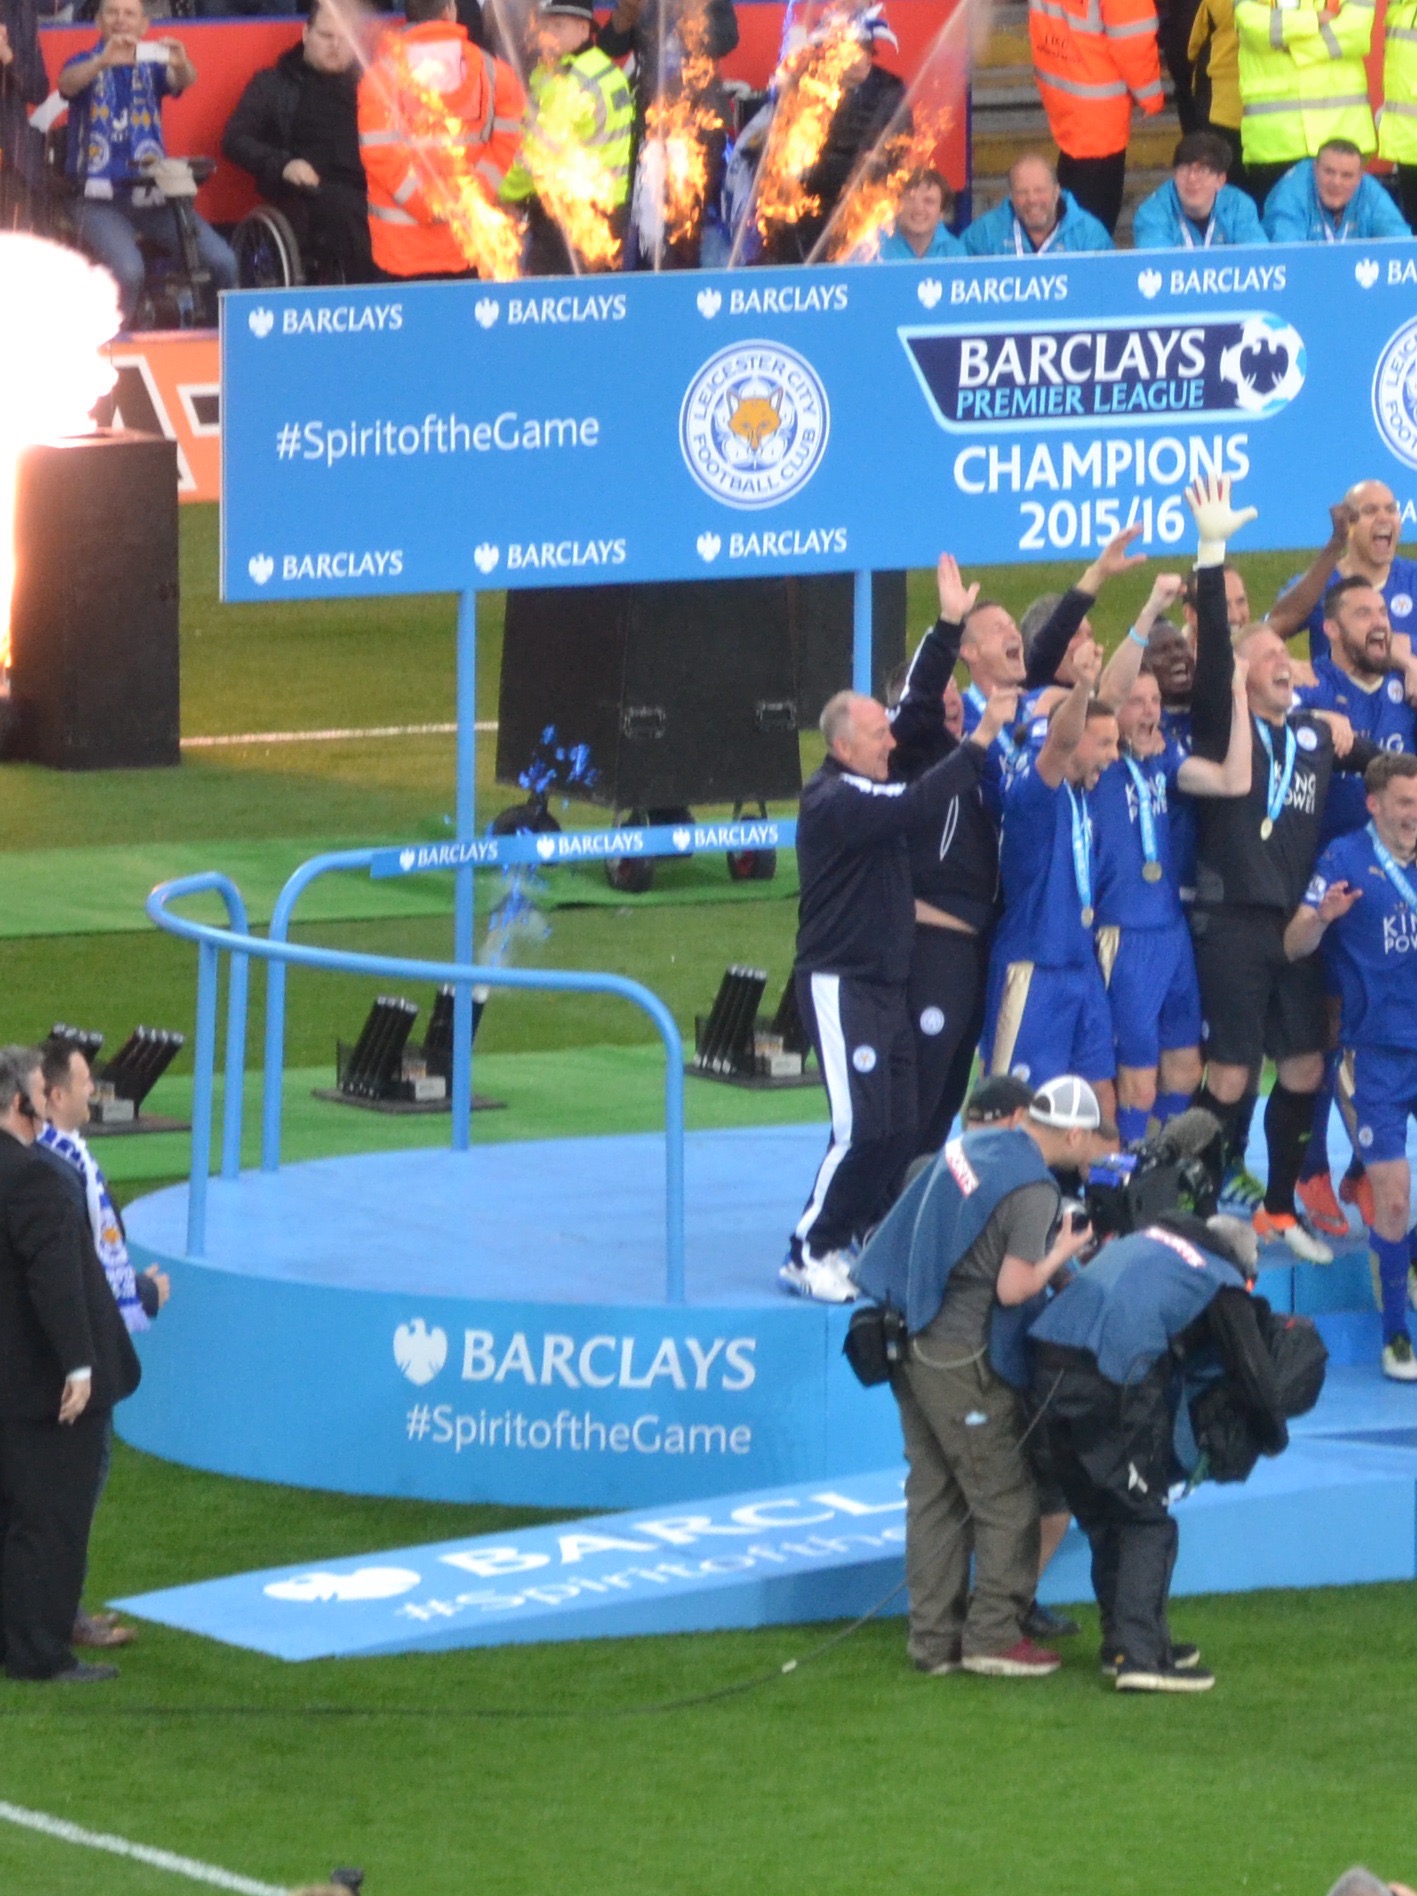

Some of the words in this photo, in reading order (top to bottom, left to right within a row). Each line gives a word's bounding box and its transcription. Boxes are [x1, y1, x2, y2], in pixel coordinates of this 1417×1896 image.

[950, 274, 1068, 304] BARCLAYS
[1170, 265, 1287, 295] BARCLAYS
[507, 294, 627, 325] BARCLAYS
[729, 284, 848, 315] BARCLAYS
[282, 303, 403, 334] BARCLAYS
[957, 328, 1206, 389] BARCLAYS
[694, 355, 786, 421] LEICESTER
[787, 371, 817, 416] CITY
[955, 385, 1083, 420] PREMIER
[1094, 379, 1206, 414] LEAGUE
[276, 411, 600, 468] #SpiritoftheGame
[693, 434, 778, 493] FOOTBALL
[780, 427, 817, 480] CLUB
[953, 433, 1250, 494] CHAMPIONS
[1018, 495, 1186, 550] 2015/16
[507, 538, 627, 570] BARCLAYS
[729, 527, 848, 559] BARCLAYS
[282, 550, 404, 581] BARCLAYS
[1274, 760, 1316, 796] KNG
[558, 831, 644, 856] BARCLAYS
[694, 824, 779, 848] BARCLAYS
[417, 841, 498, 867] BARCLAYS
[461, 1328, 757, 1391] BARCLAYS
[406, 1403, 752, 1456] #SpiritoftheGame
[438, 1485, 908, 1578] BARCL
